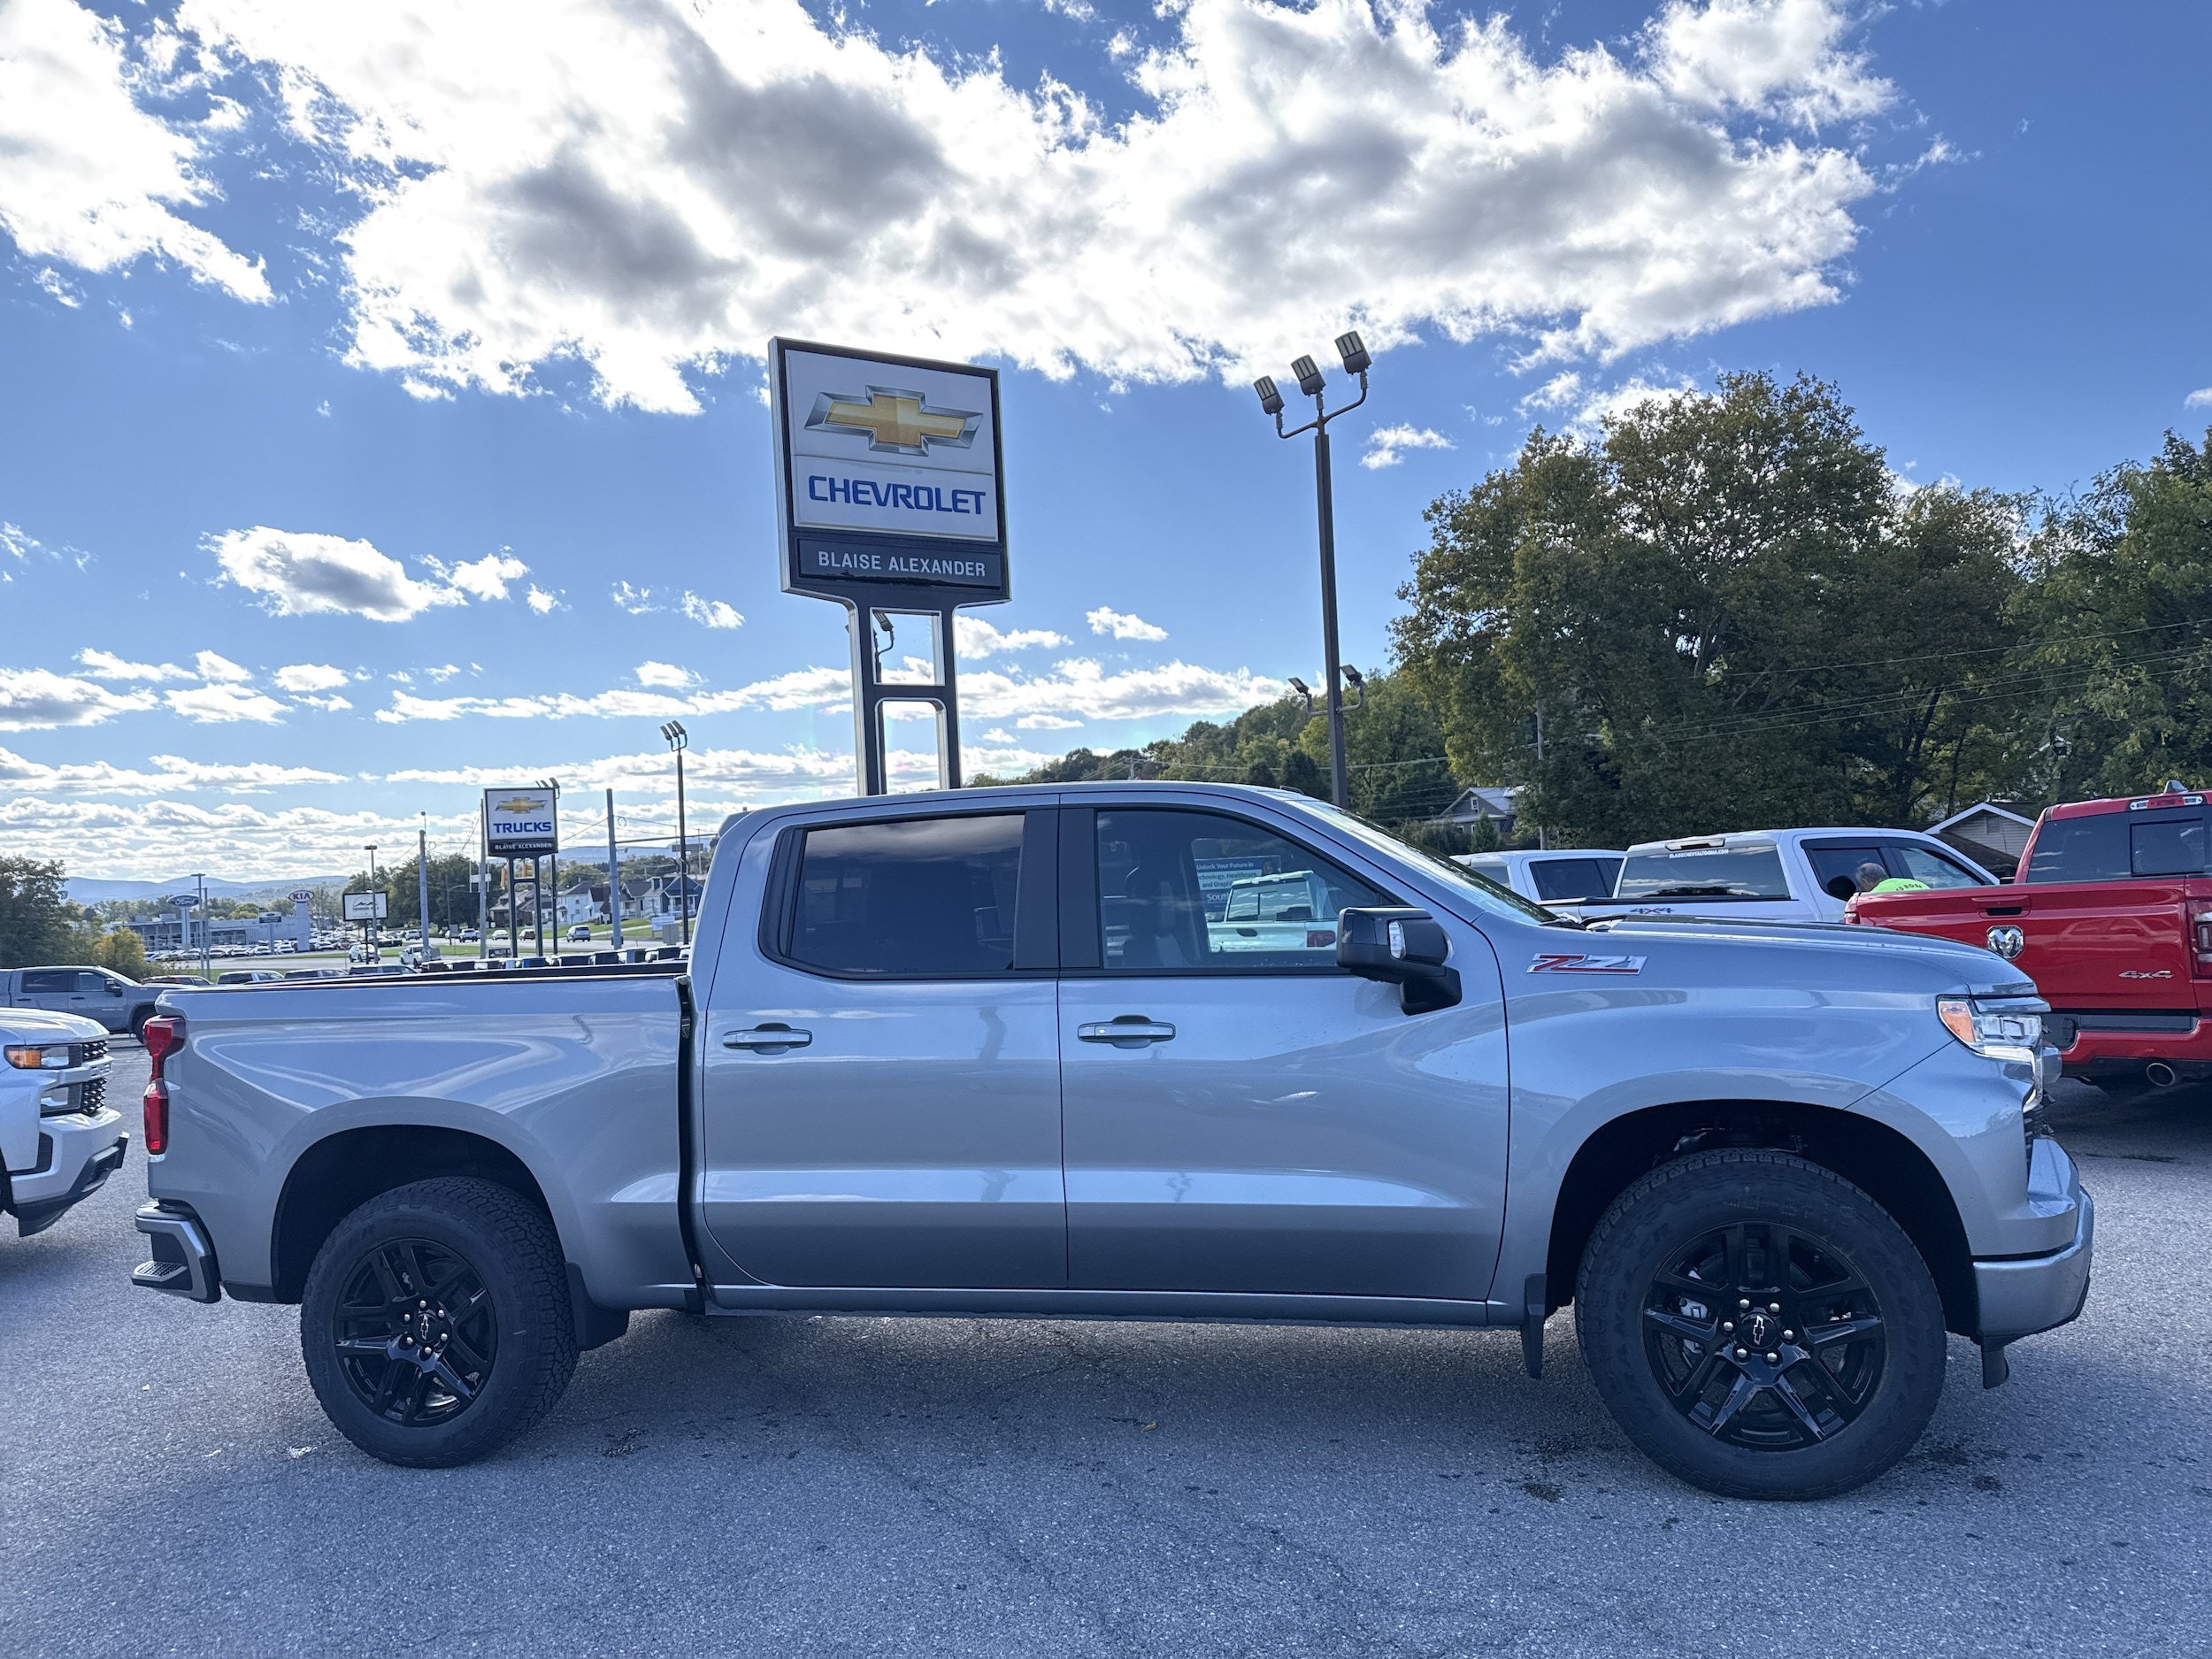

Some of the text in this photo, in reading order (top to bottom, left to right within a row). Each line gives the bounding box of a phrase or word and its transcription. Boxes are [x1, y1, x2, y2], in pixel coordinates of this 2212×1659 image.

[809, 475, 987, 515] CHEVROLET
[818, 550, 987, 577] BLAISE ALEXANDER
[493, 821, 552, 833] TRUCKS
[174, 896, 196, 907] Ford
[292, 892, 311, 901] KIA
[1526, 952, 1648, 976] Z71
